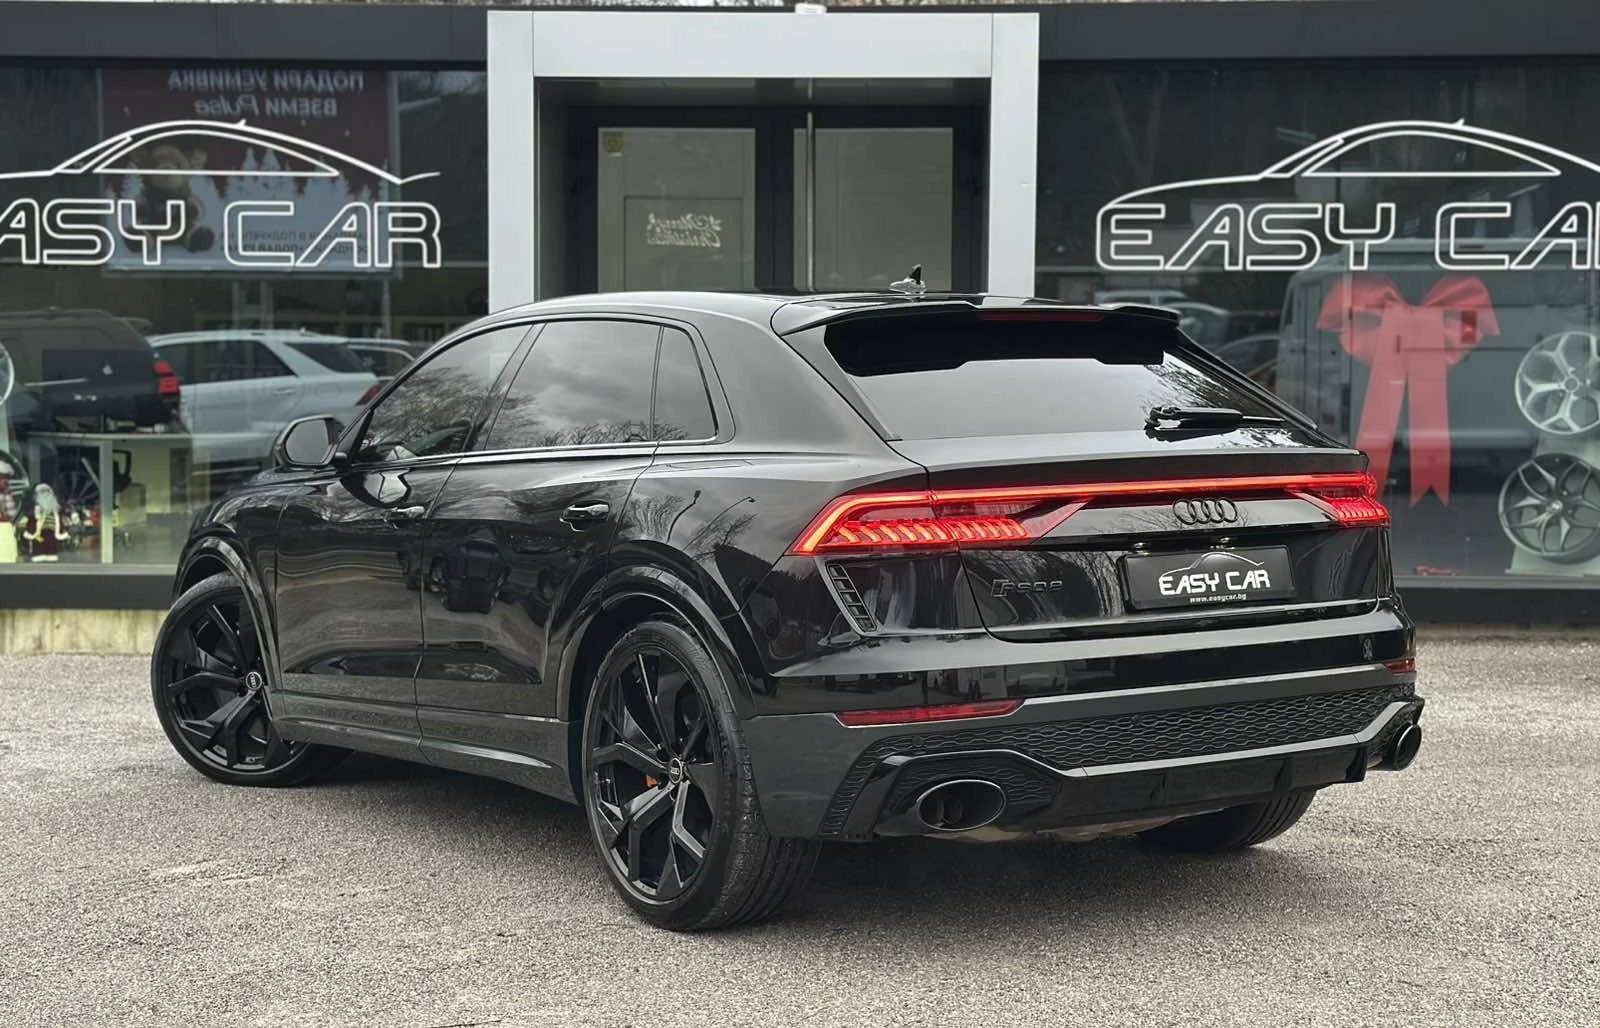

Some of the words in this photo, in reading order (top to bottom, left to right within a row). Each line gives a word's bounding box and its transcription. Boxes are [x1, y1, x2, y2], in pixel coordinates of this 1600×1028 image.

[223, 201, 442, 268] CAR
[1096, 202, 1396, 270] EASY
[1435, 201, 1600, 270] CA
[1158, 572, 1220, 596] EASY
[1225, 569, 1271, 591] CAR
[1189, 593, 1247, 604] www.easycar.bg
